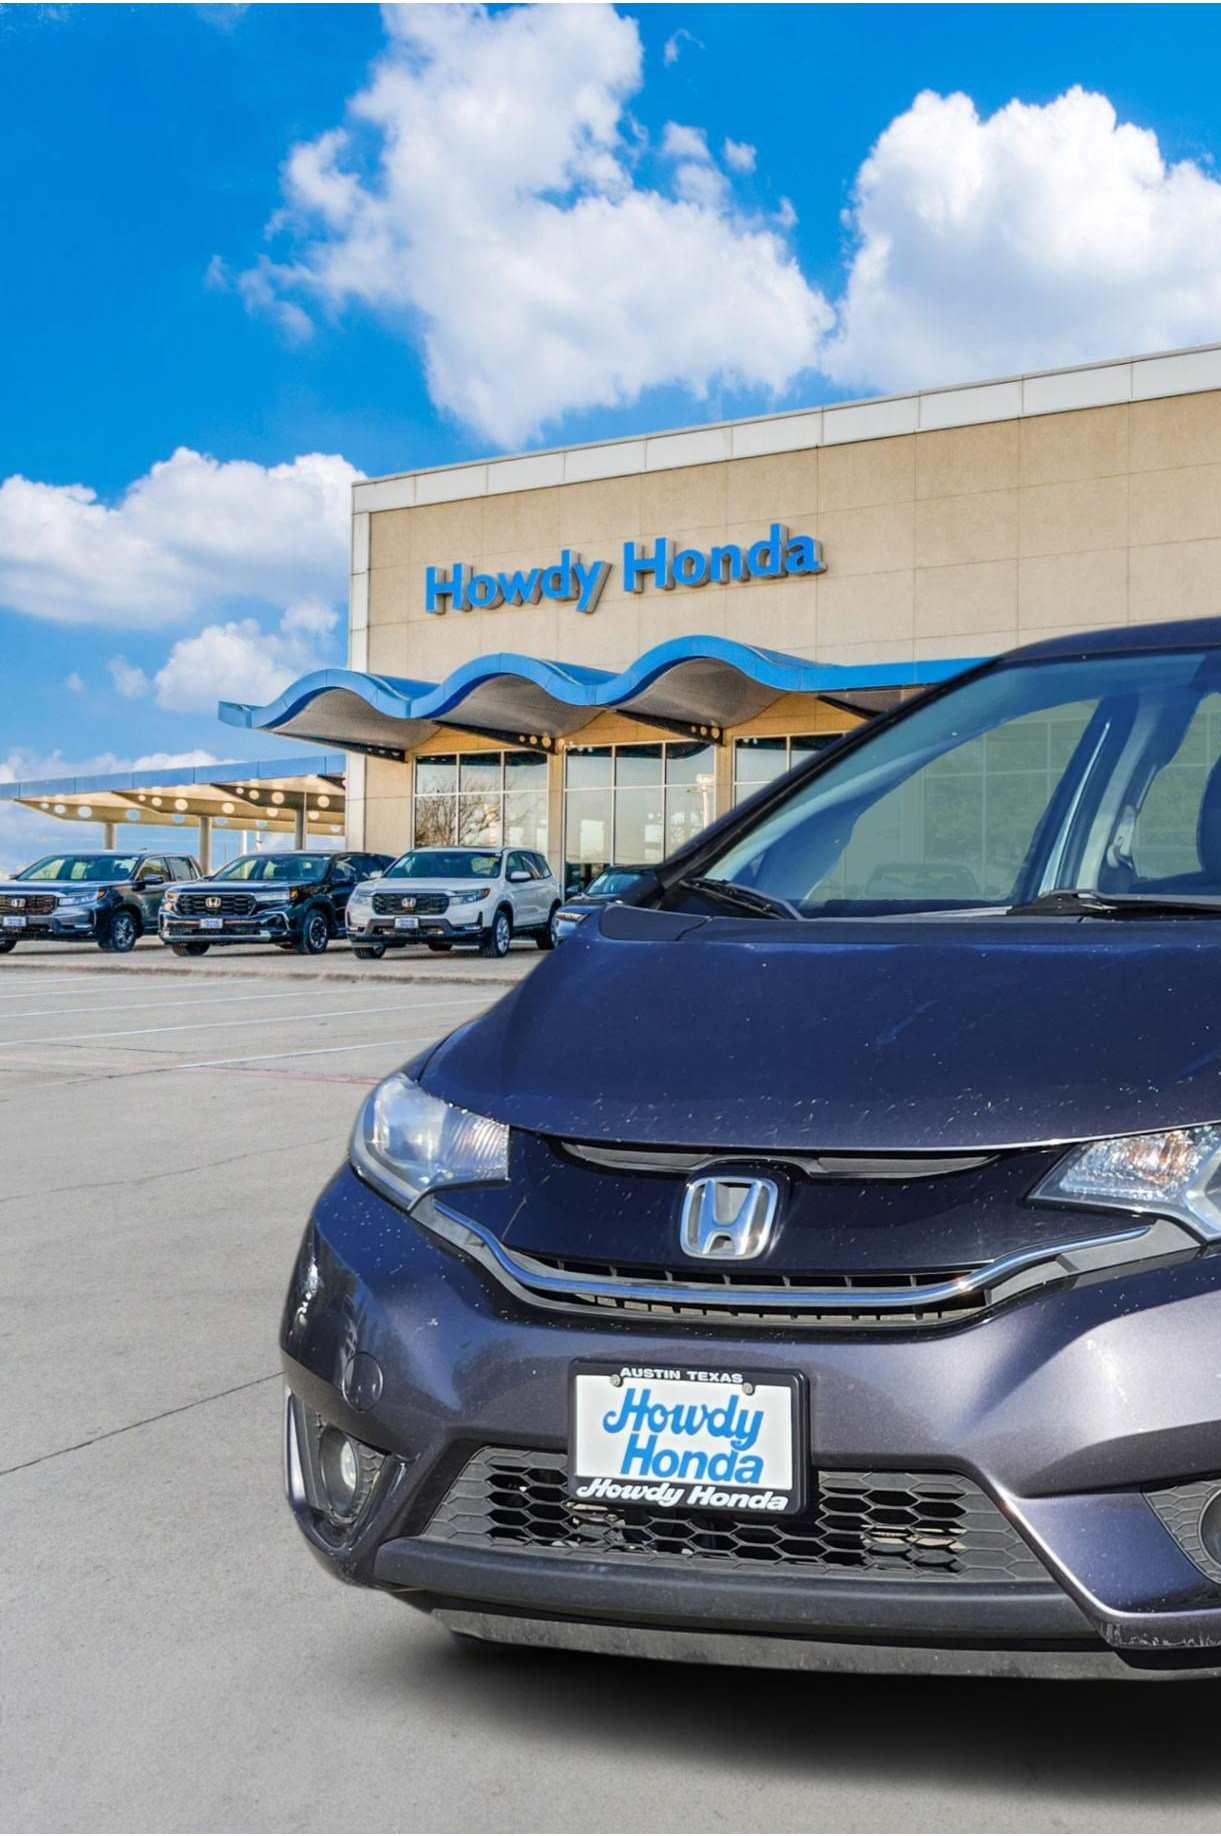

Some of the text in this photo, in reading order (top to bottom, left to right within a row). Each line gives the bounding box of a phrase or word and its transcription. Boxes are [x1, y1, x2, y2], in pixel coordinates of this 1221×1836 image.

[425, 523, 827, 615] Howdy Honda
[620, 1367, 744, 1384] AUSTIN TEXAS
[603, 1388, 764, 1450] Howdy
[620, 1434, 764, 1484] Honda
[577, 1478, 788, 1511] Howdy Honda
